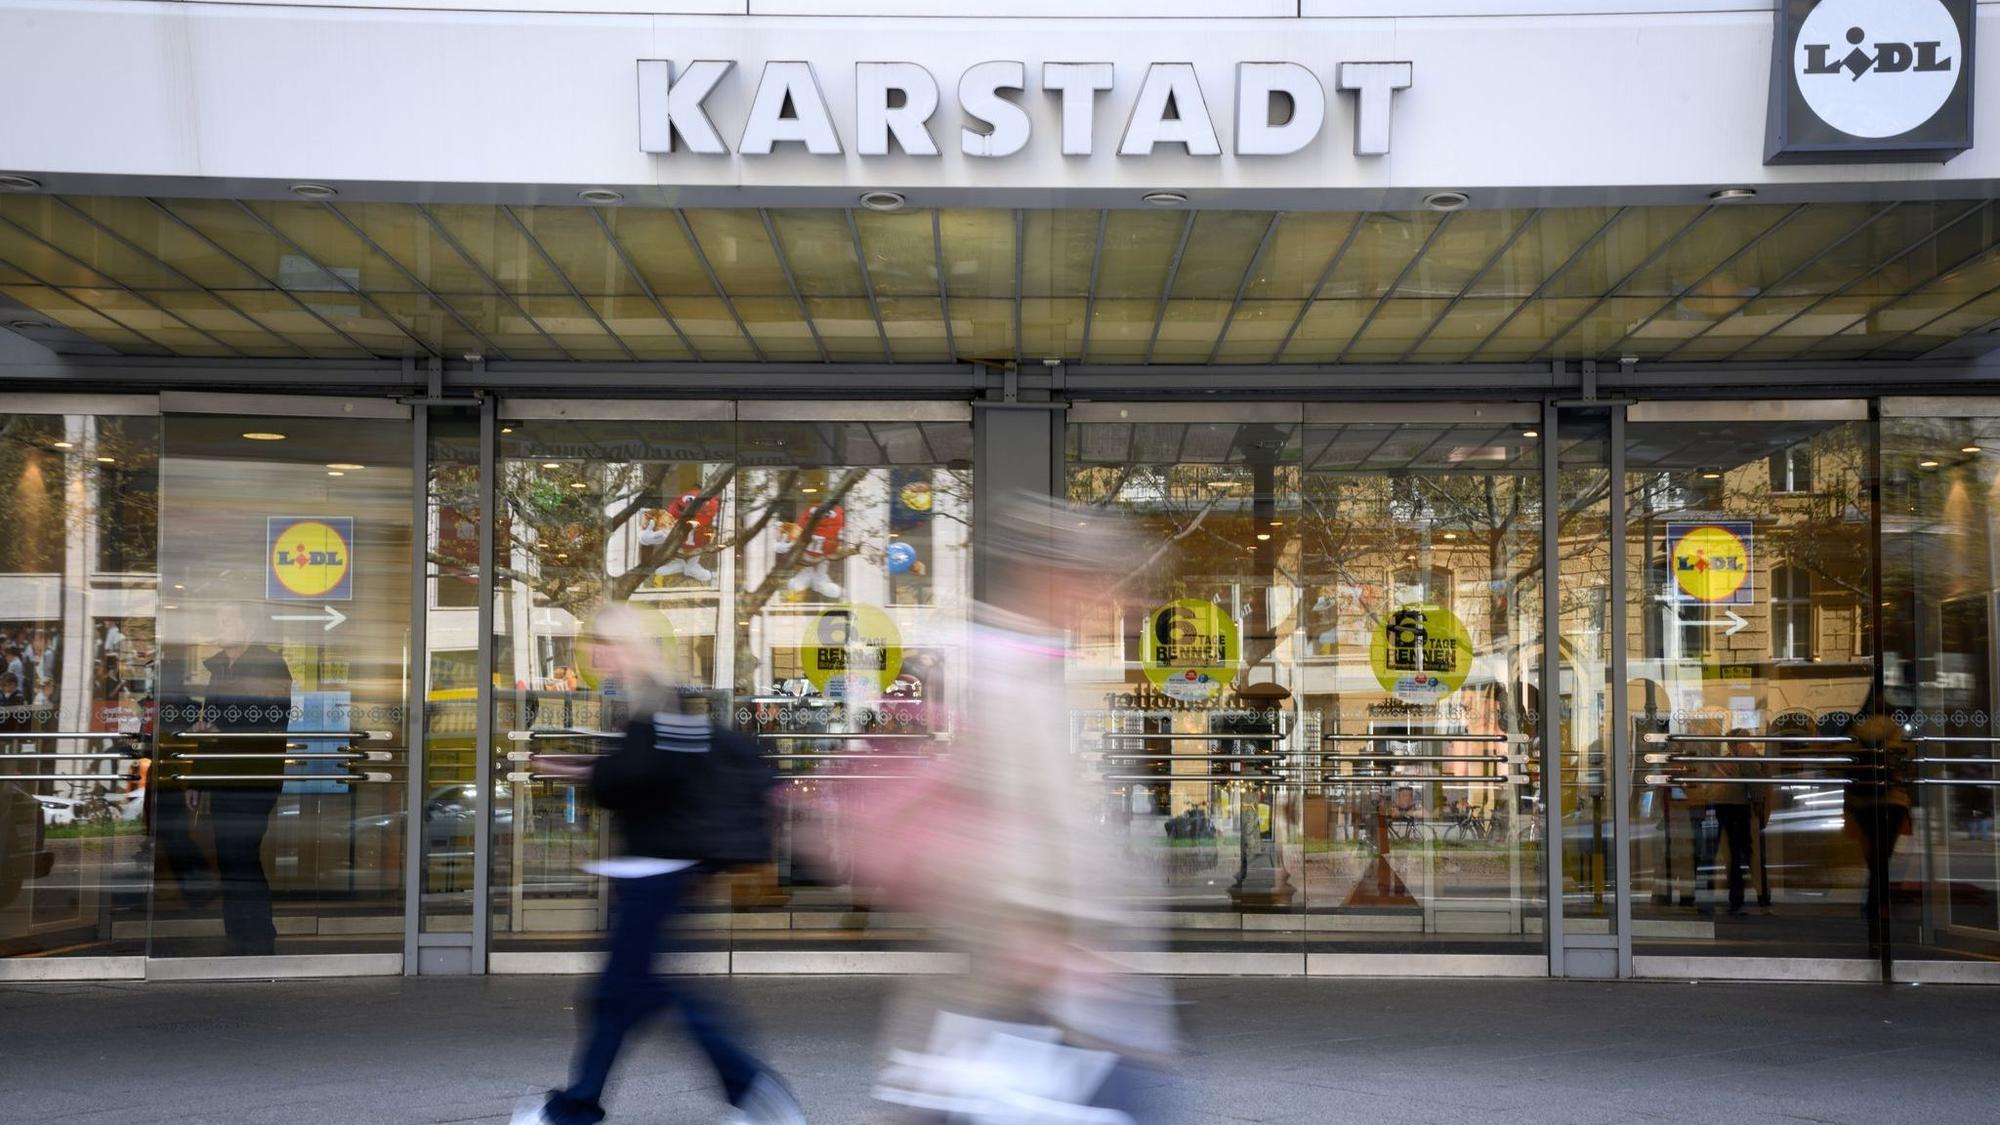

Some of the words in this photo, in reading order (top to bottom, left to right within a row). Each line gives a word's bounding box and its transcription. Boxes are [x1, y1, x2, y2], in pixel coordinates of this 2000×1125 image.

[637, 59, 1412, 157] KARSTADT
[817, 610, 858, 646] 6
[1155, 607, 1197, 645] 6
[1386, 610, 1428, 648] 6
[1429, 639, 1456, 648] TAGE
